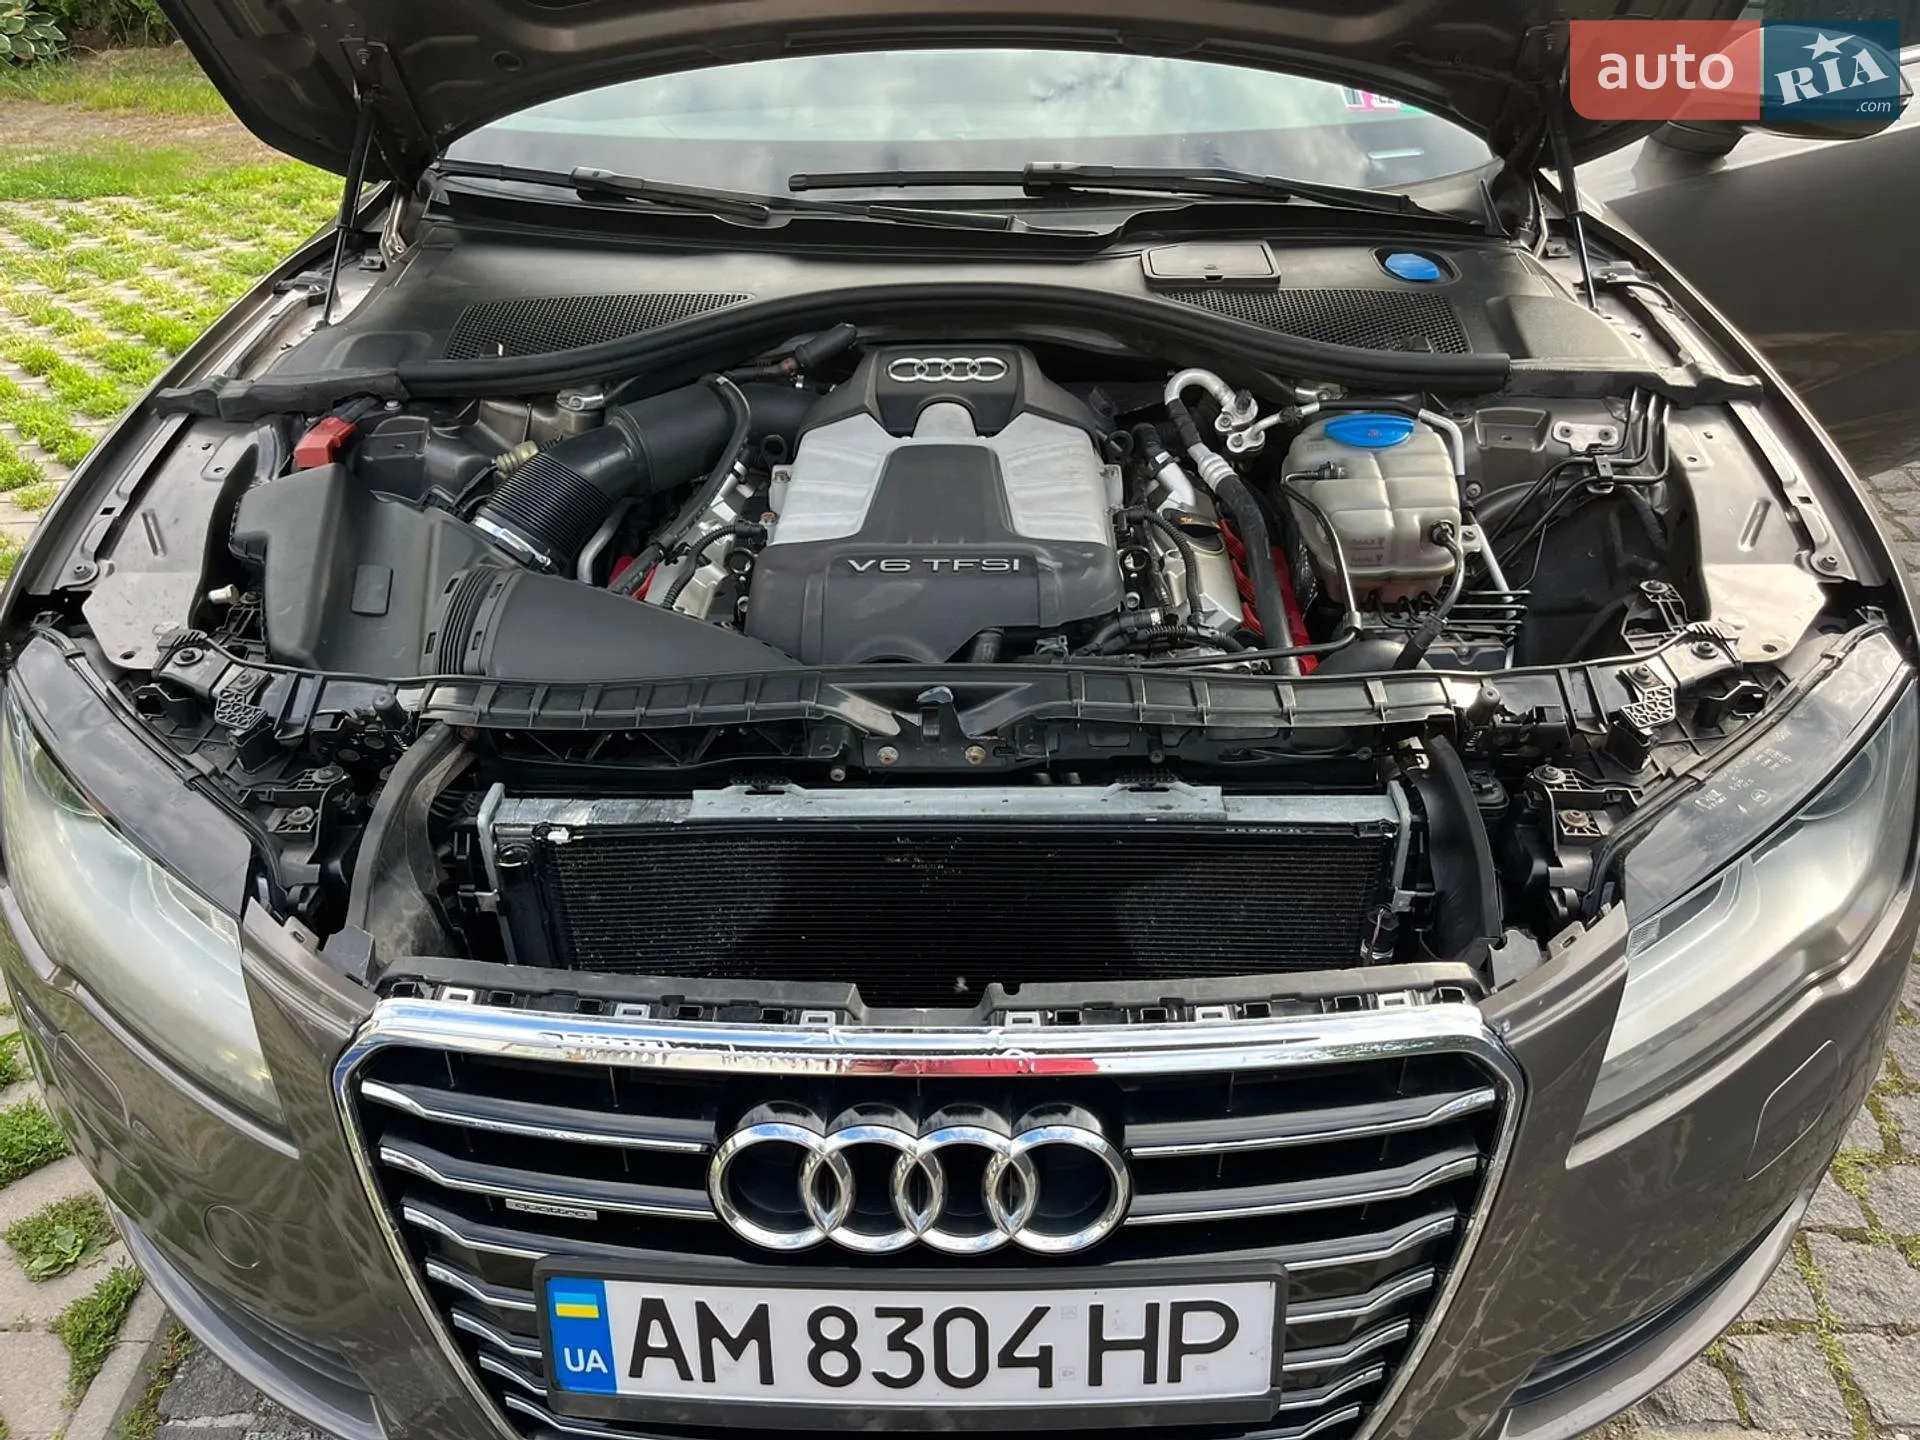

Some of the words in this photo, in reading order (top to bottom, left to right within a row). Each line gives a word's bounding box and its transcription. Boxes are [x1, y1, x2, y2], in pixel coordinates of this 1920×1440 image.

[848, 559, 911, 572] V6
[922, 559, 1020, 571] TFSI
[515, 1203, 588, 1217] quattro
[628, 1297, 775, 1386] AM
[807, 1305, 1053, 1389] 8304
[1088, 1300, 1240, 1387] HP
[564, 1347, 608, 1374] UA
